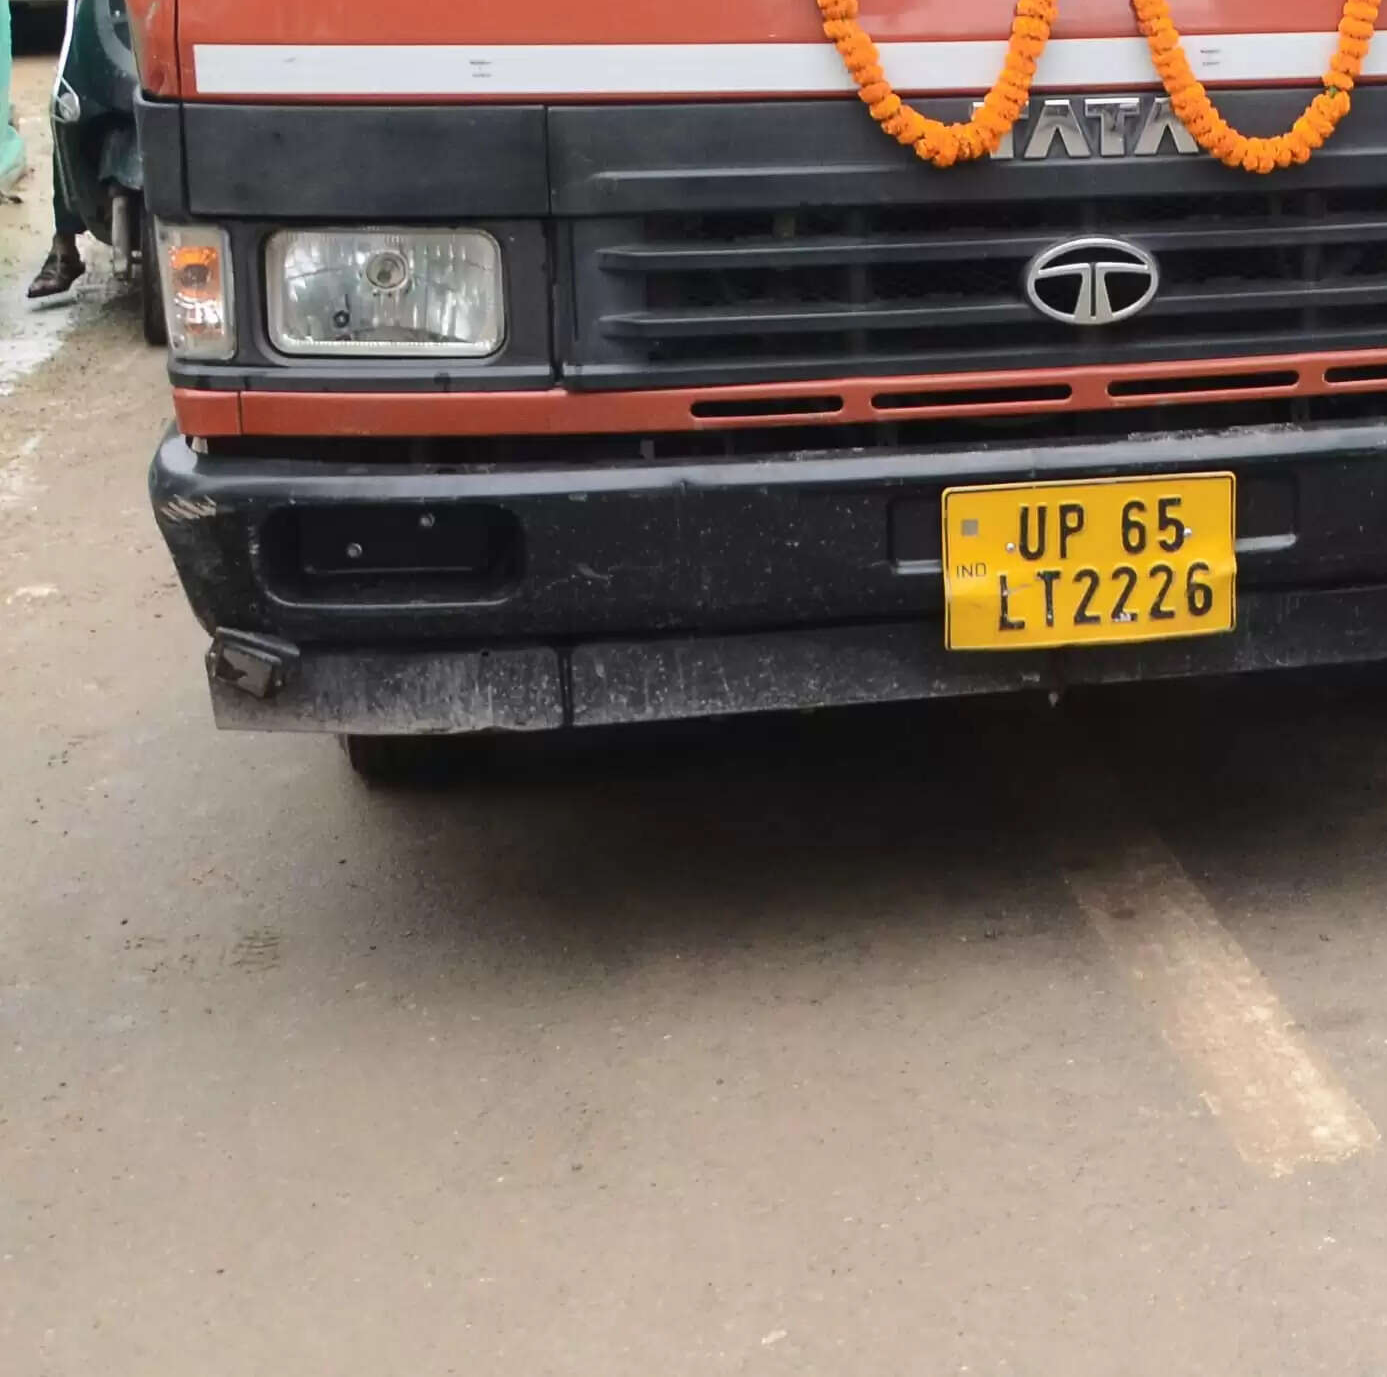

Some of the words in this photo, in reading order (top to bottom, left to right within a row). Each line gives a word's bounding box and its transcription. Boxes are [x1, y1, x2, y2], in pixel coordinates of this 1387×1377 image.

[1018, 502, 1085, 560] UP
[1121, 496, 1187, 555] 65
[955, 563, 987, 579] IND
[998, 560, 1214, 633] LT2226
